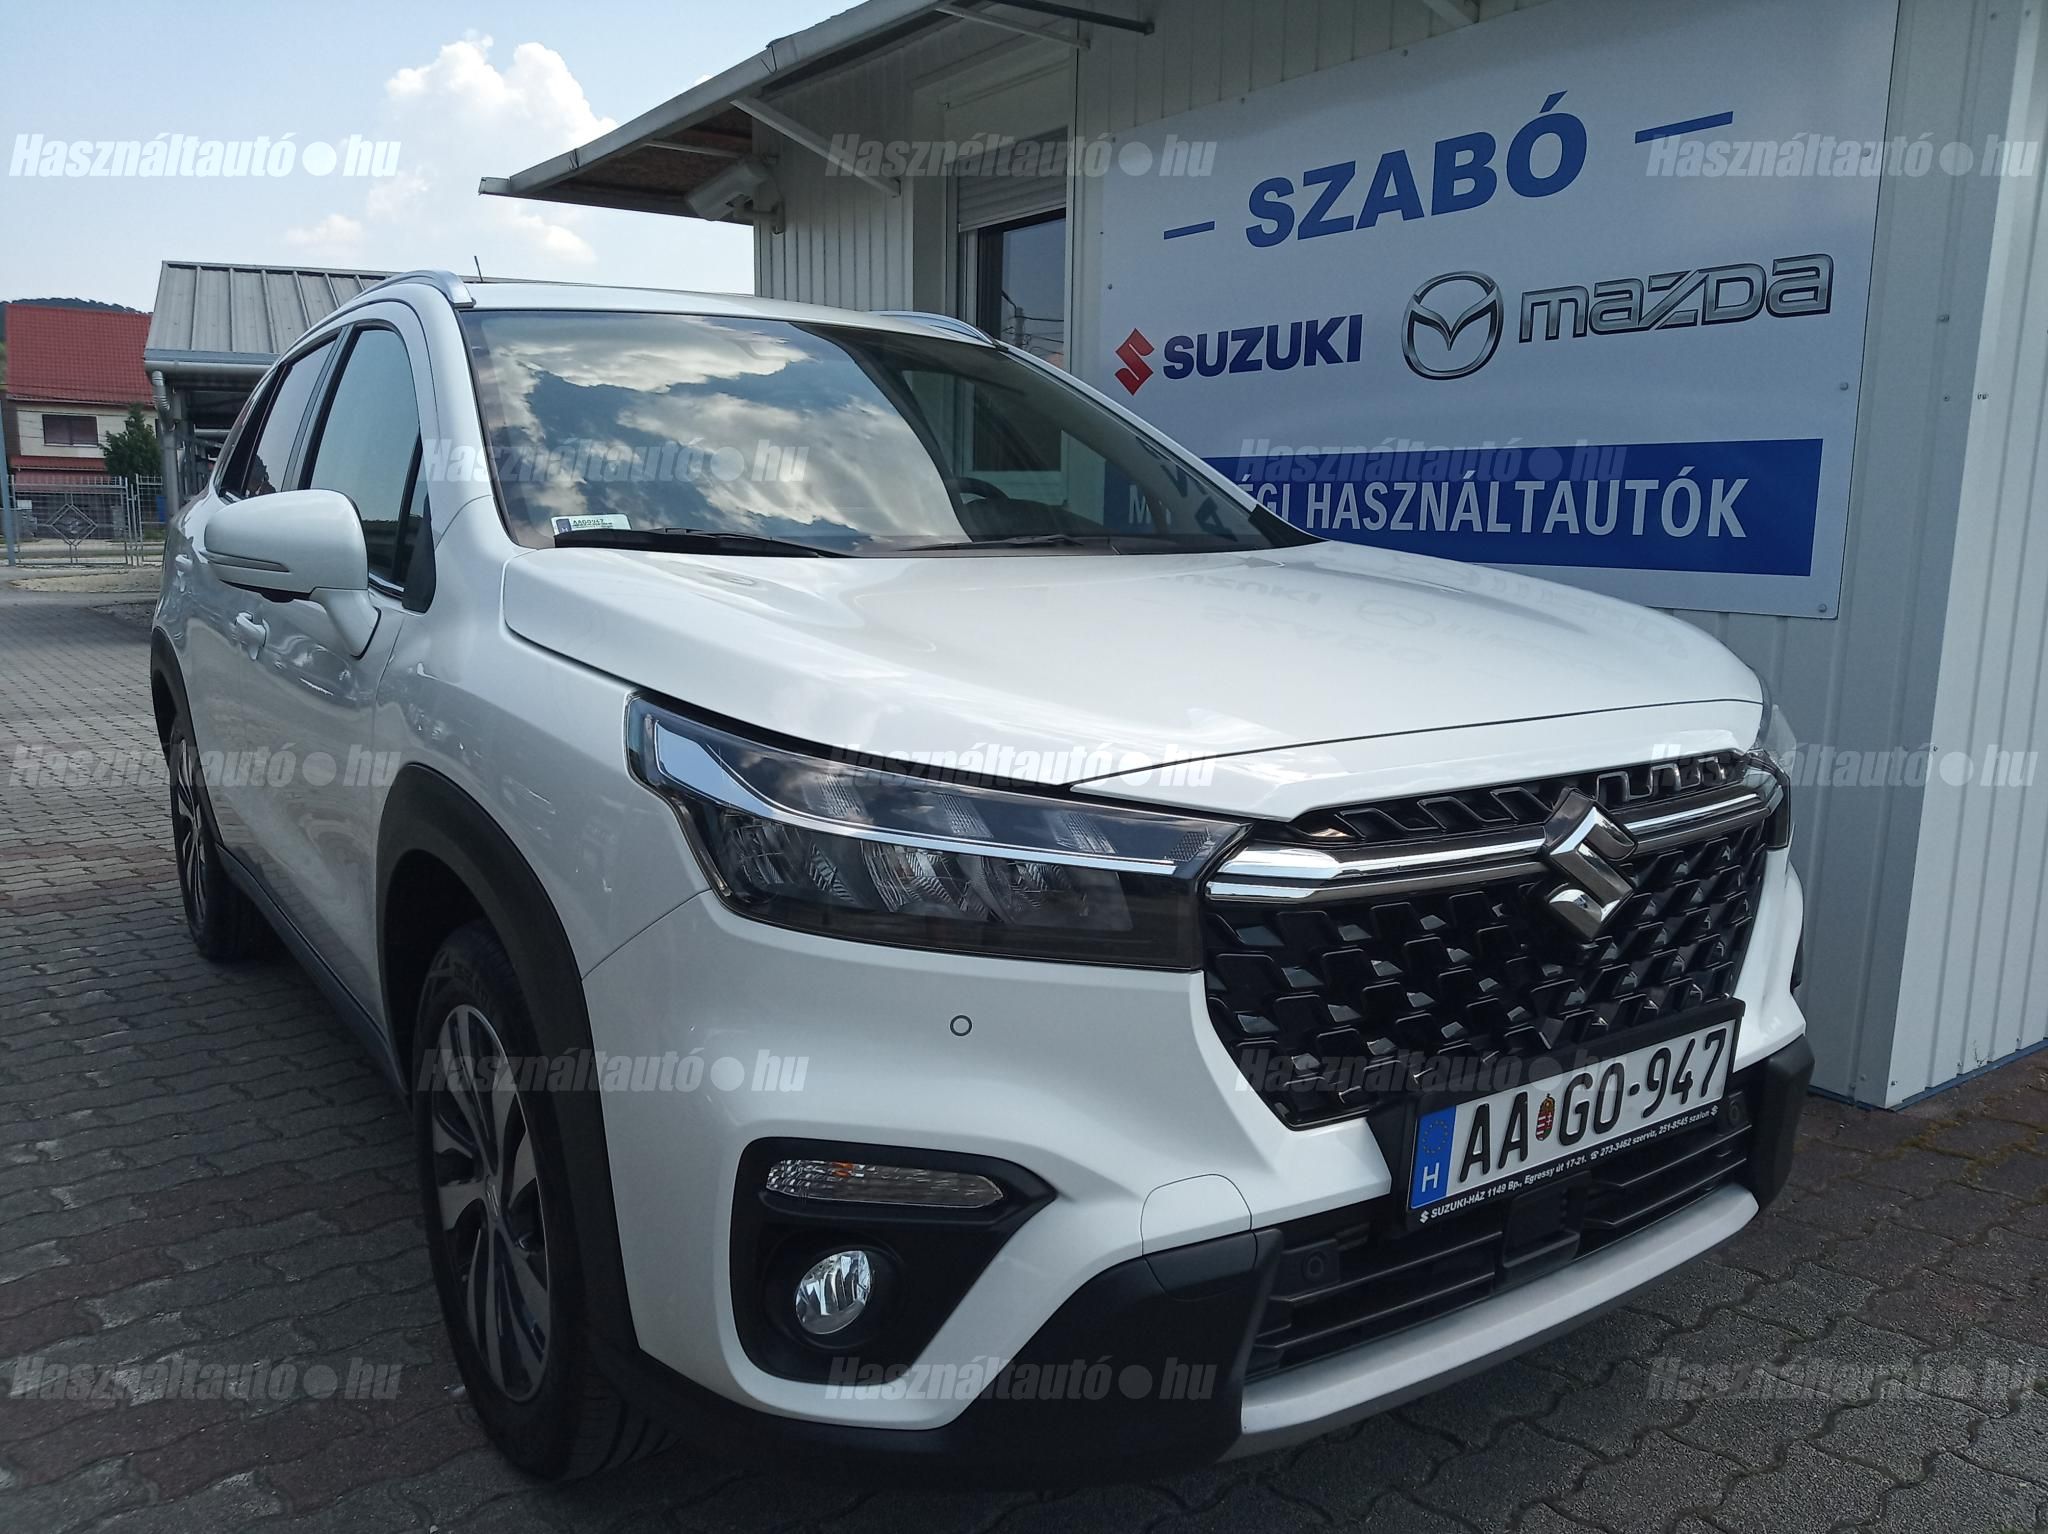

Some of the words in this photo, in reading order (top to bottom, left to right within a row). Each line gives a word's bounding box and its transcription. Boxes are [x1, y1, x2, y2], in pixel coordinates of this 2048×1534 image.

[1245, 91, 1588, 248] SZABÓ
[1164, 314, 1362, 380] SUZUKI
[1306, 465, 1747, 541] HASZNÁLTAUTÓK
[1459, 1091, 1529, 1183] AA
[1558, 1027, 1728, 1147] GO-947
[1421, 1162, 1440, 1193] H
[1430, 1190, 1486, 1219] SUZUKI-HÁZ
[1487, 1183, 1507, 1198] 1149
[1524, 1166, 1555, 1185] Egressy
[1688, 1110, 1710, 1124] szalon
